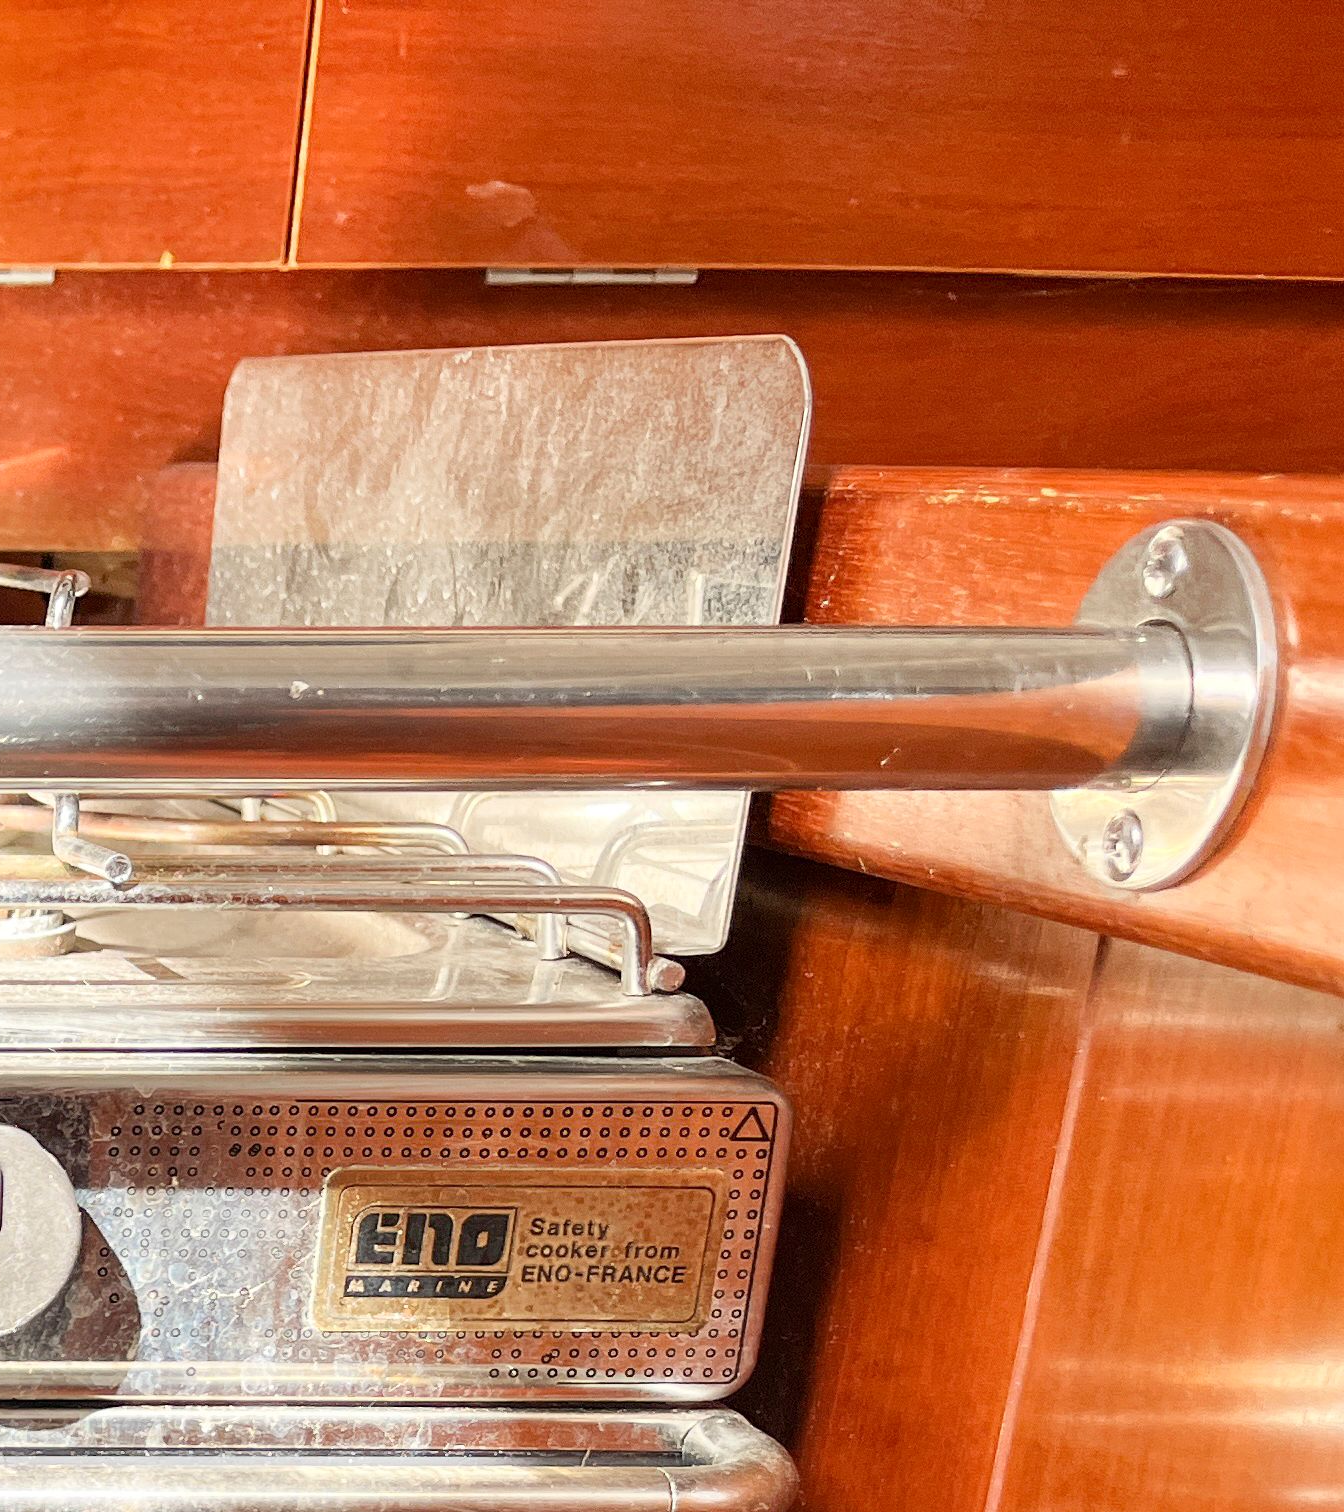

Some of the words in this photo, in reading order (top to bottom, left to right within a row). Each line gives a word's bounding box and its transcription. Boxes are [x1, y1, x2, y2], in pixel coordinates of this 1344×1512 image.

[530, 1217, 610, 1240] Safety
[525, 1242, 609, 1259] cooker
[623, 1242, 680, 1260] from
[521, 1264, 687, 1284] ENO-FRANCE
[346, 1279, 499, 1294] MARINE
